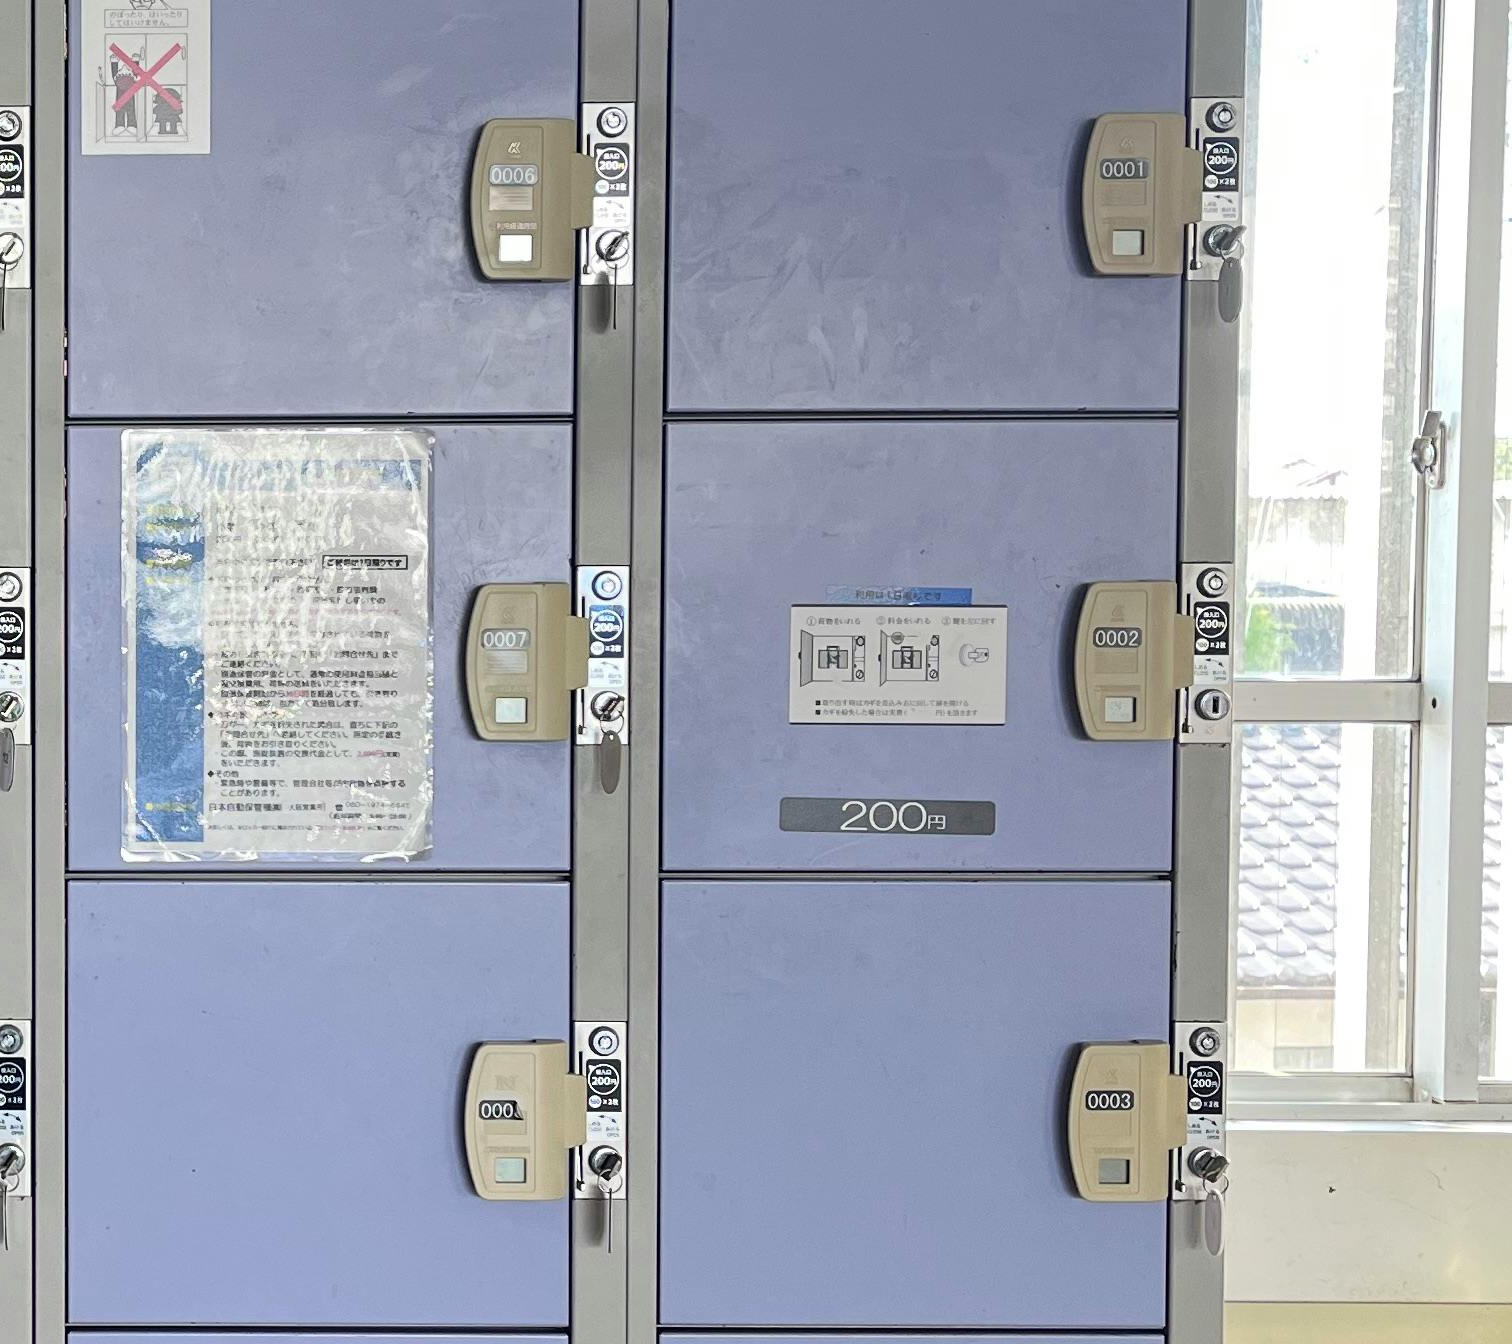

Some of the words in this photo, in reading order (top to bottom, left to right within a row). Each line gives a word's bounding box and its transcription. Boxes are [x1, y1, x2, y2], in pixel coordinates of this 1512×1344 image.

[491, 167, 536, 184] 0006
[1102, 161, 1144, 178] 0001
[483, 631, 526, 648] 0007
[1095, 630, 1139, 647] 0002
[840, 800, 946, 832] 200円
[1087, 1093, 1131, 1109] 0003
[481, 1103, 520, 1119] 000
